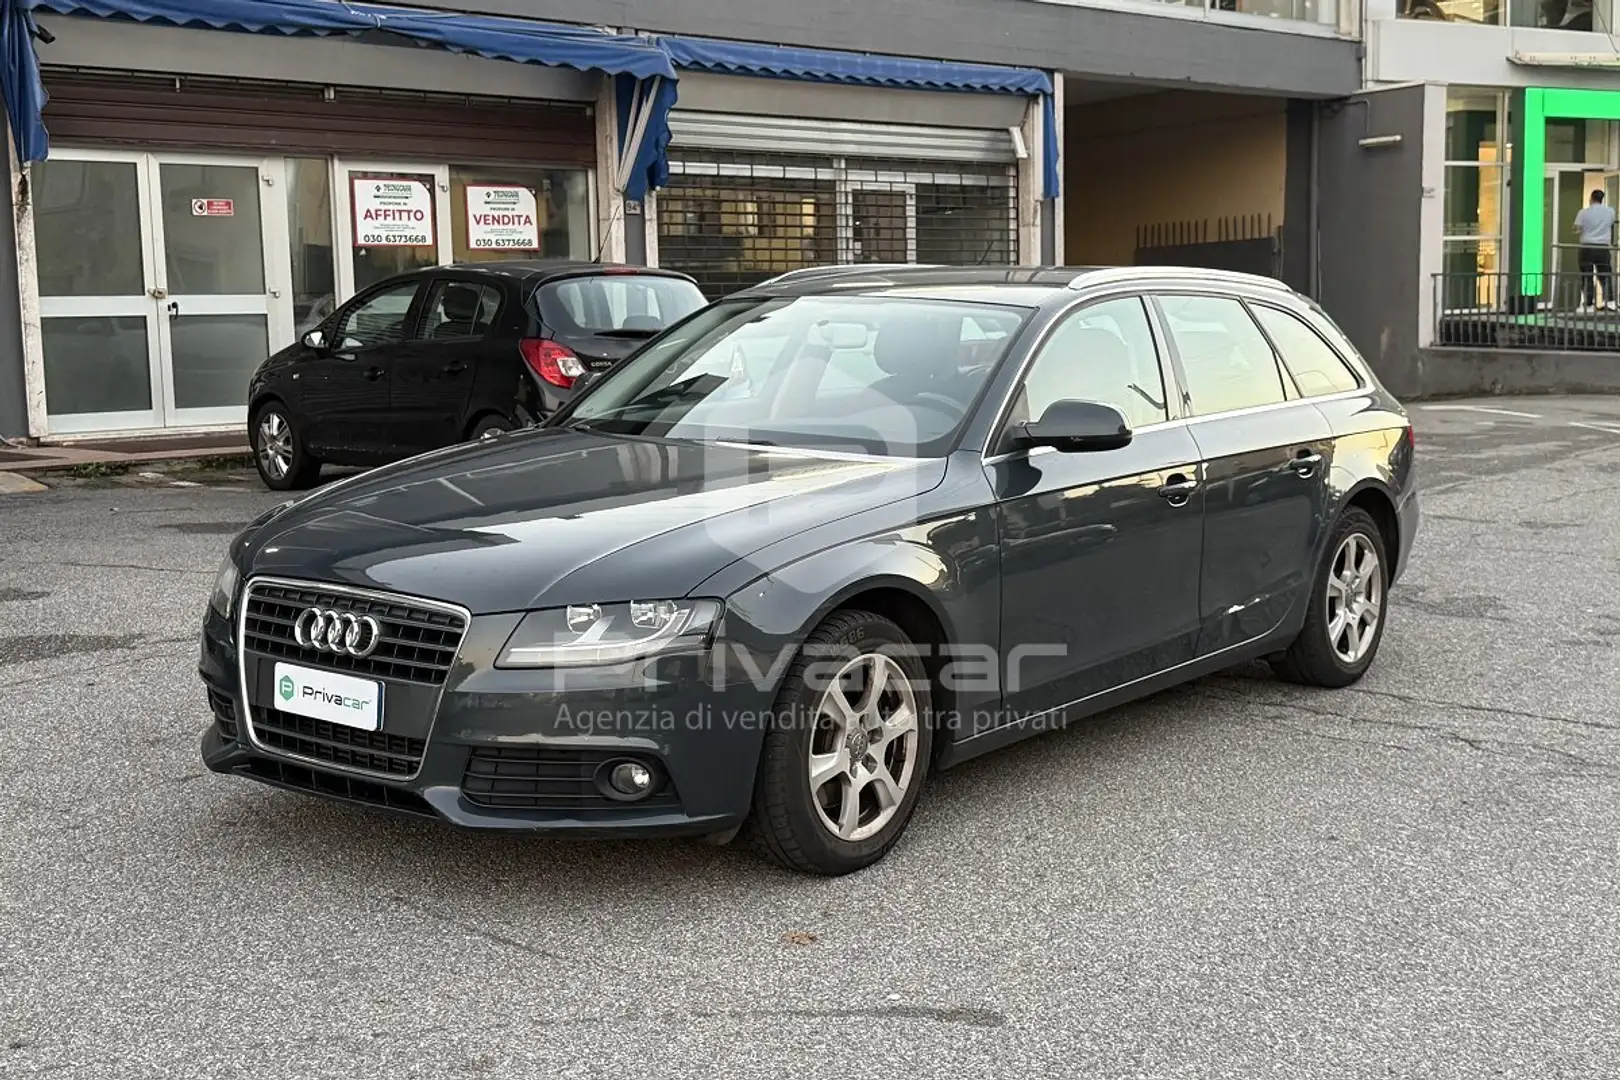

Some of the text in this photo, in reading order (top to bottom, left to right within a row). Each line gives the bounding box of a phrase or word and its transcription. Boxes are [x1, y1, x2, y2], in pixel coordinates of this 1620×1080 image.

[363, 208, 425, 221] AFFITTO
[473, 214, 533, 226] VENDITA
[363, 234, 427, 243] 030 6373668
[475, 238, 533, 247] 030 6373668
